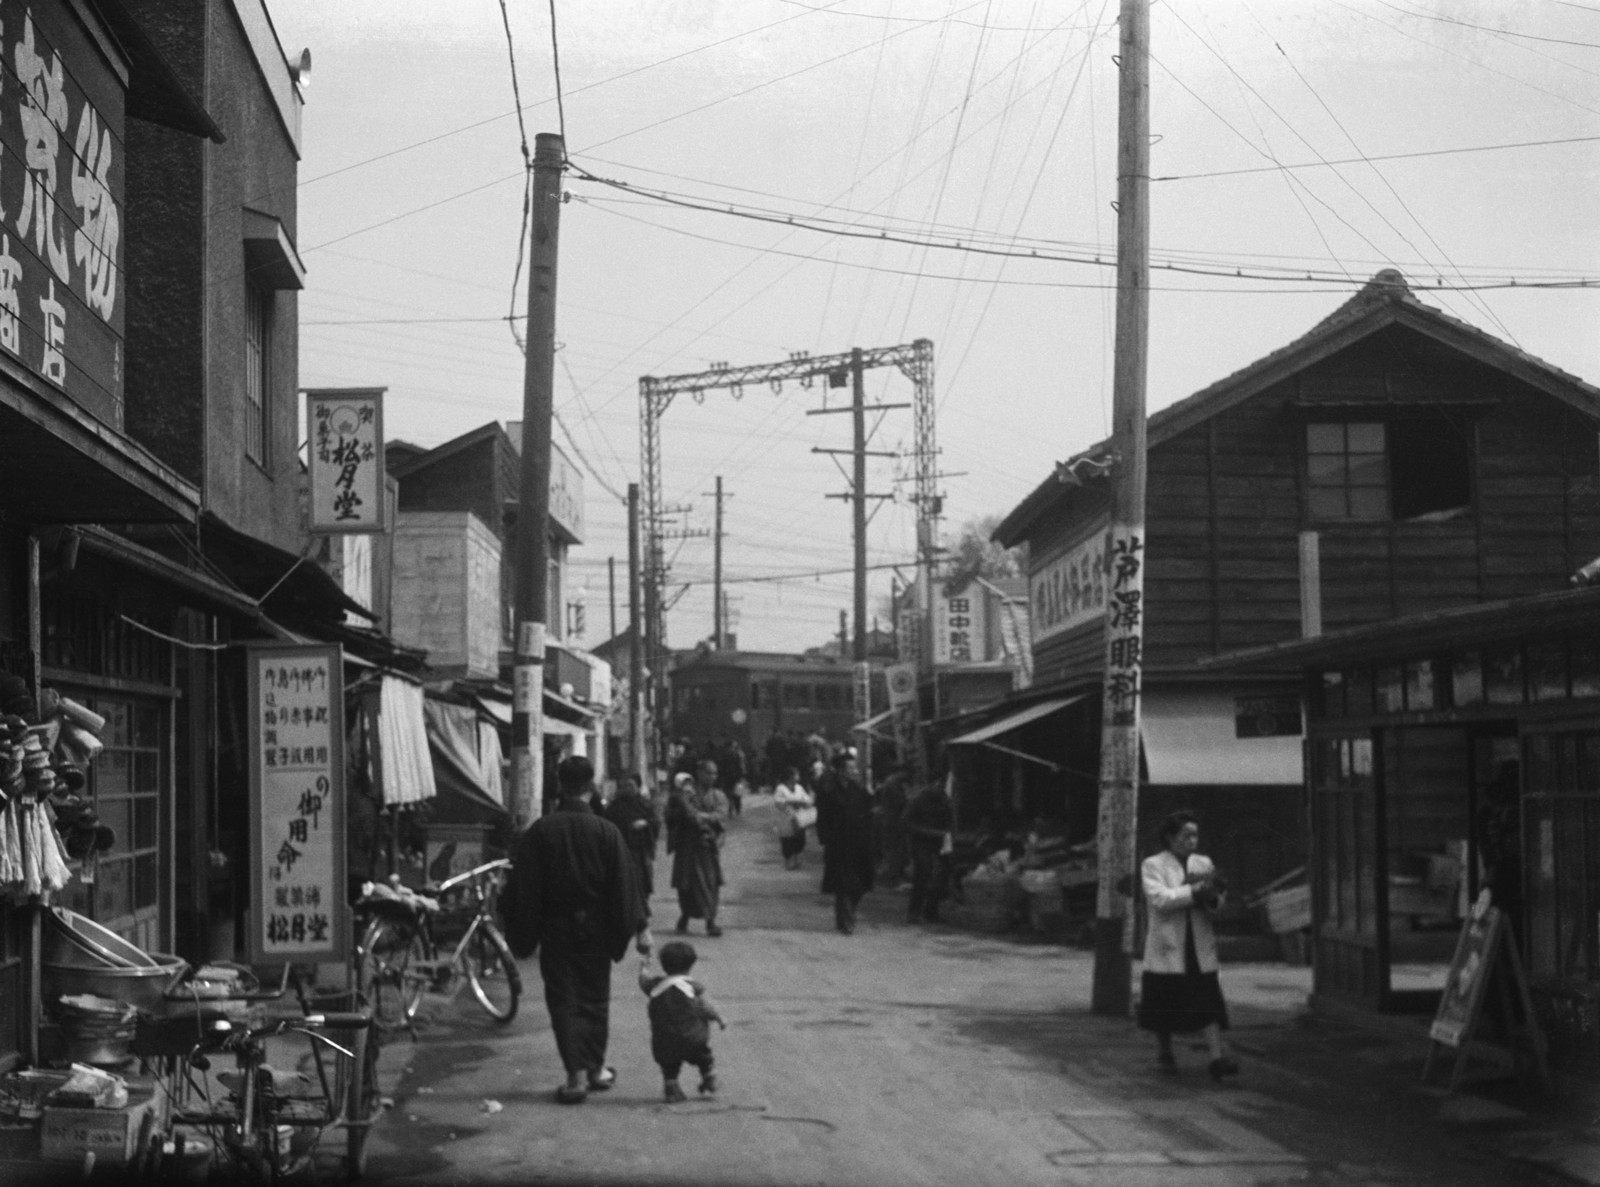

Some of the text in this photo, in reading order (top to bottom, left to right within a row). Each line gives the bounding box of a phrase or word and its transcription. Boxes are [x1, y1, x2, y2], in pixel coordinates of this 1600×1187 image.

[0, 3, 119, 323] 荒物
[333, 434, 363, 521] 松月堂
[267, 912, 329, 945] 松月堂
